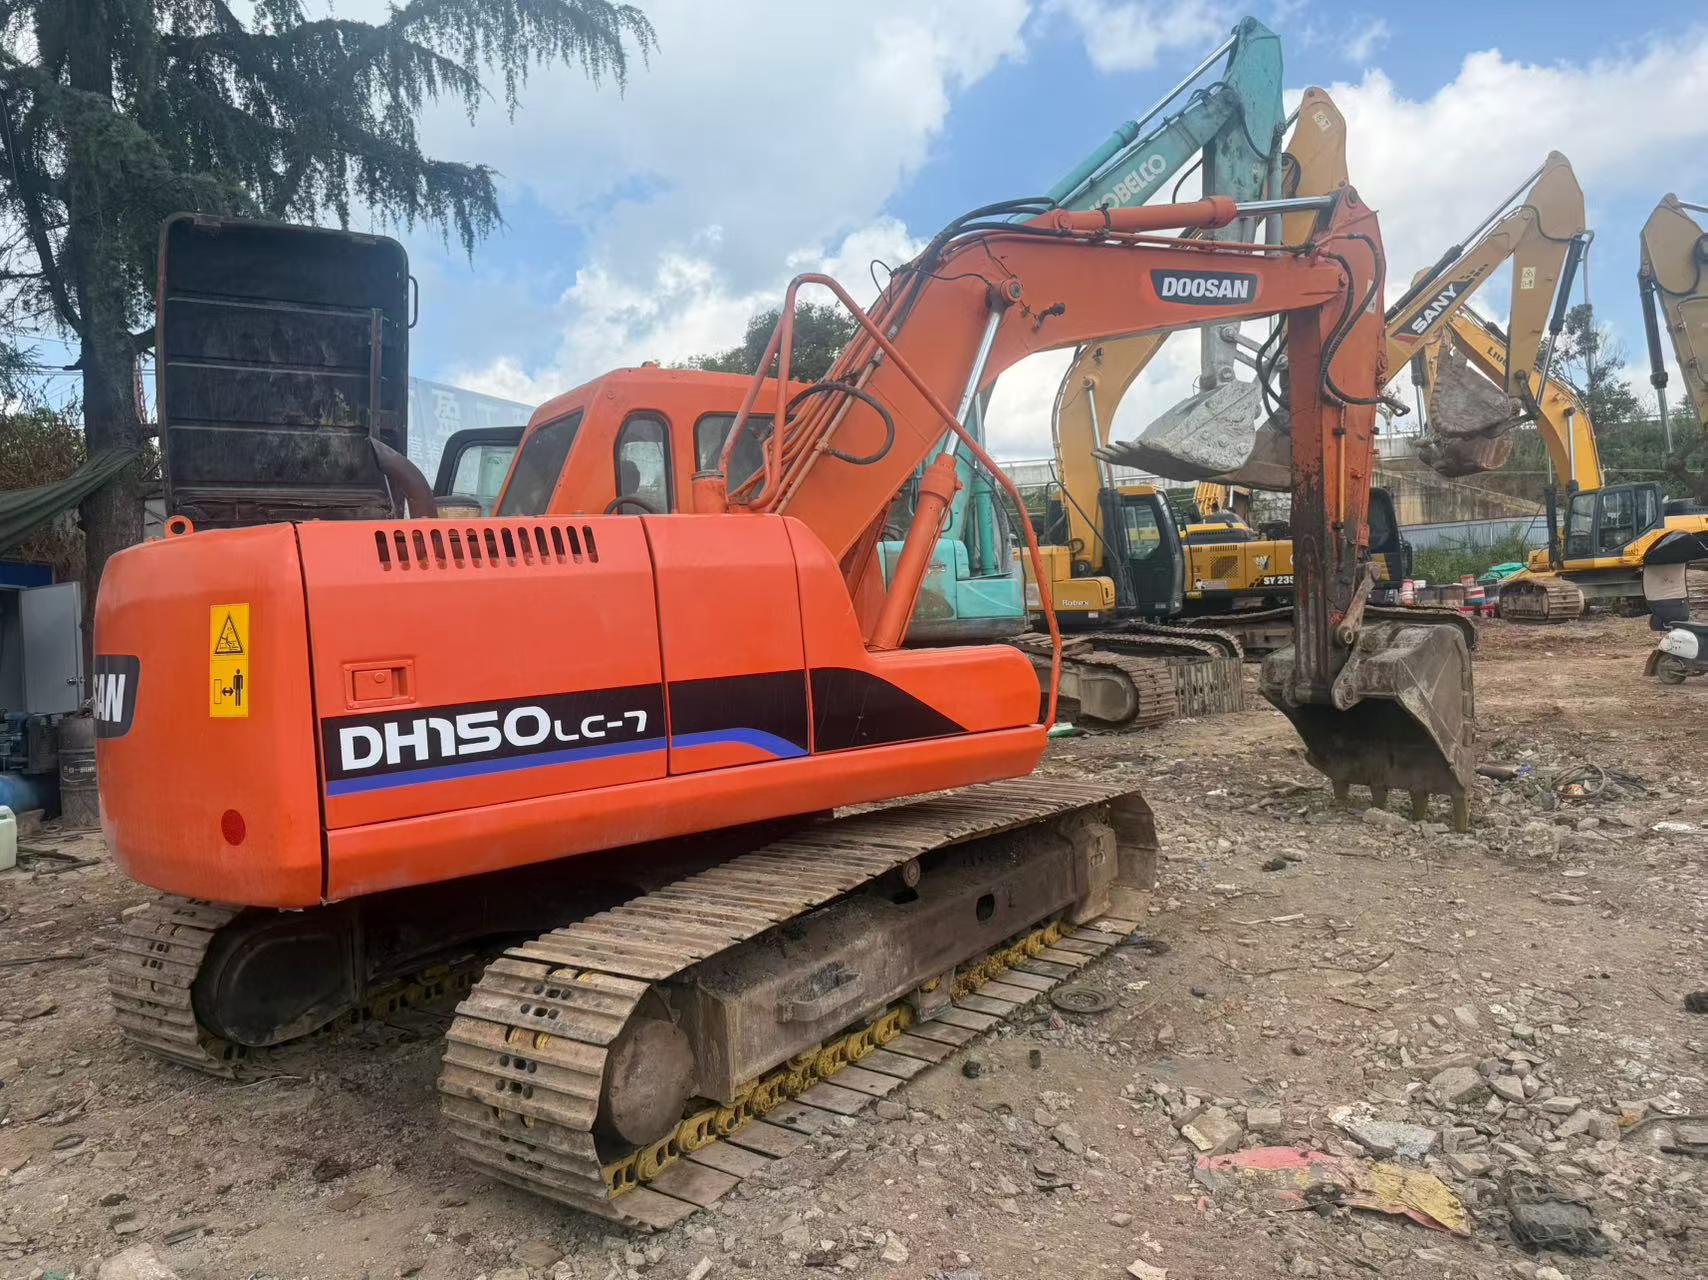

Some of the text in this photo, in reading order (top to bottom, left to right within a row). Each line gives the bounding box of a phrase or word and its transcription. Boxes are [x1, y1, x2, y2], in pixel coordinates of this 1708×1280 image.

[1162, 277, 1249, 298] DOOSAN
[1411, 283, 1457, 334] SANY
[1263, 576, 1275, 585] SY
